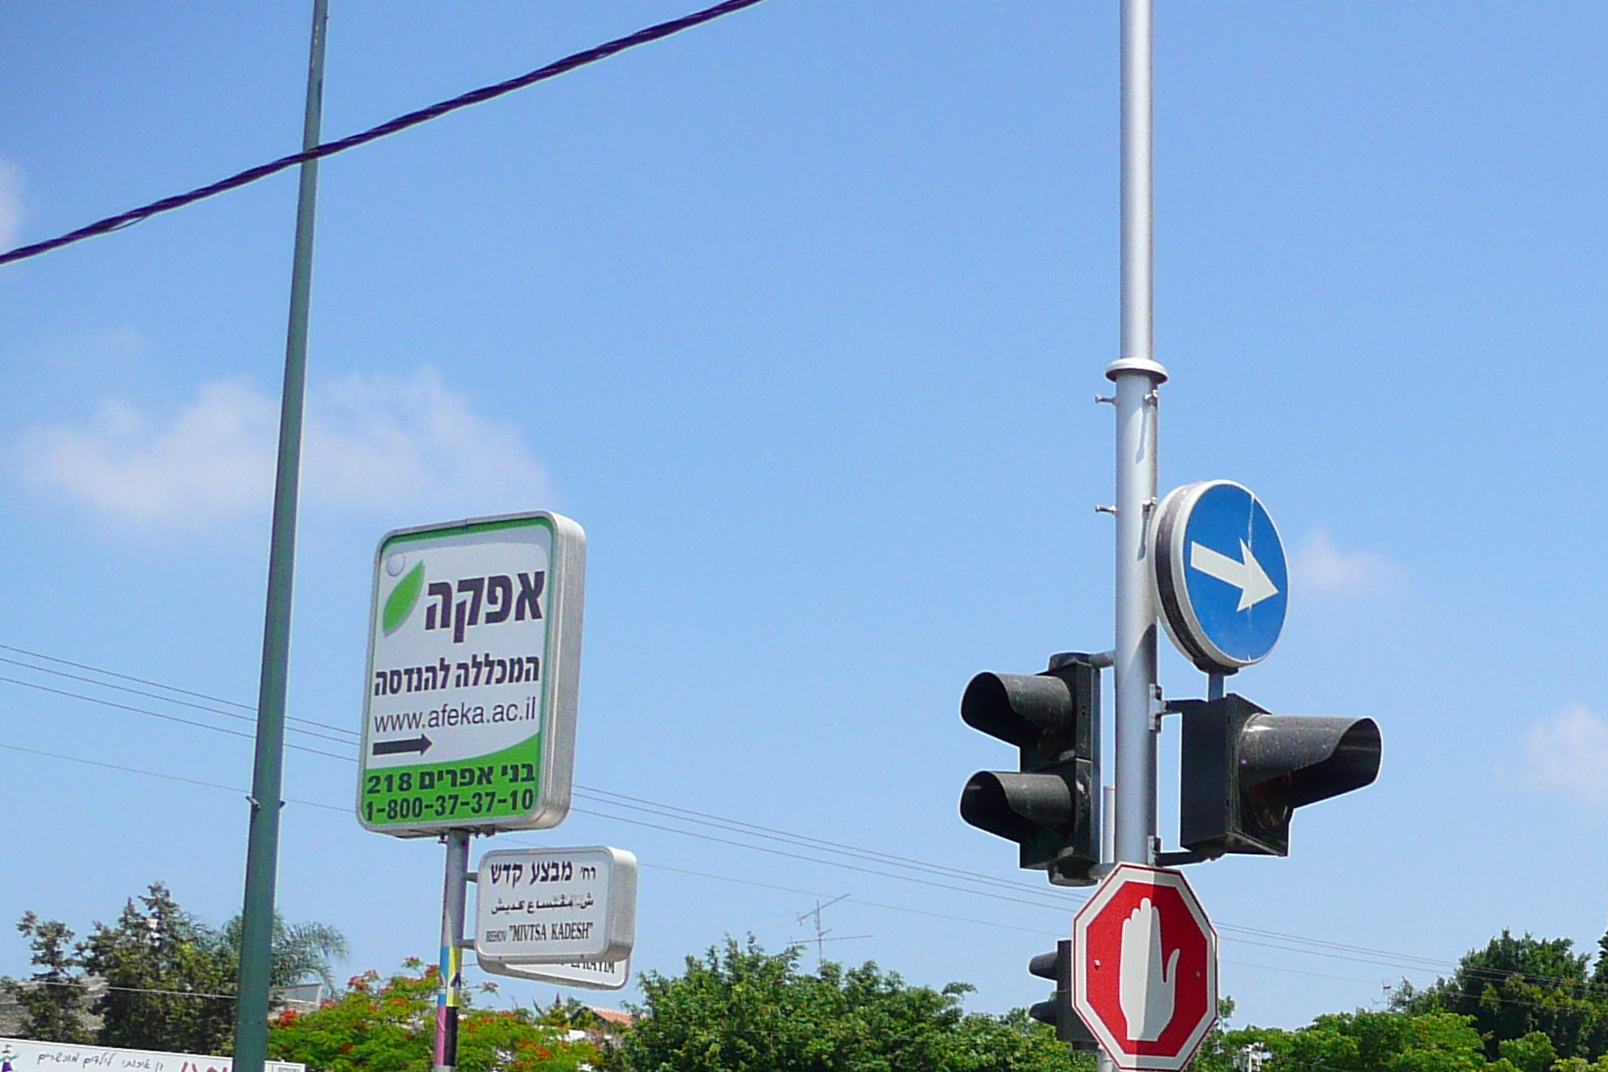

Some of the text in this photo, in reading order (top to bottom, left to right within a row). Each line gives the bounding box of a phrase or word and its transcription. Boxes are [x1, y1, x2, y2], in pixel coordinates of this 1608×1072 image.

[424, 570, 545, 644] אפקה
[374, 653, 540, 696] המכללה להנדסה
[374, 696, 536, 733] www.afeka.ac.il
[366, 763, 535, 794] בני אפרים 218
[366, 788, 534, 821] 1-800-37-37-10
[490, 863, 523, 889] קדש
[529, 861, 573, 886] מבצע
